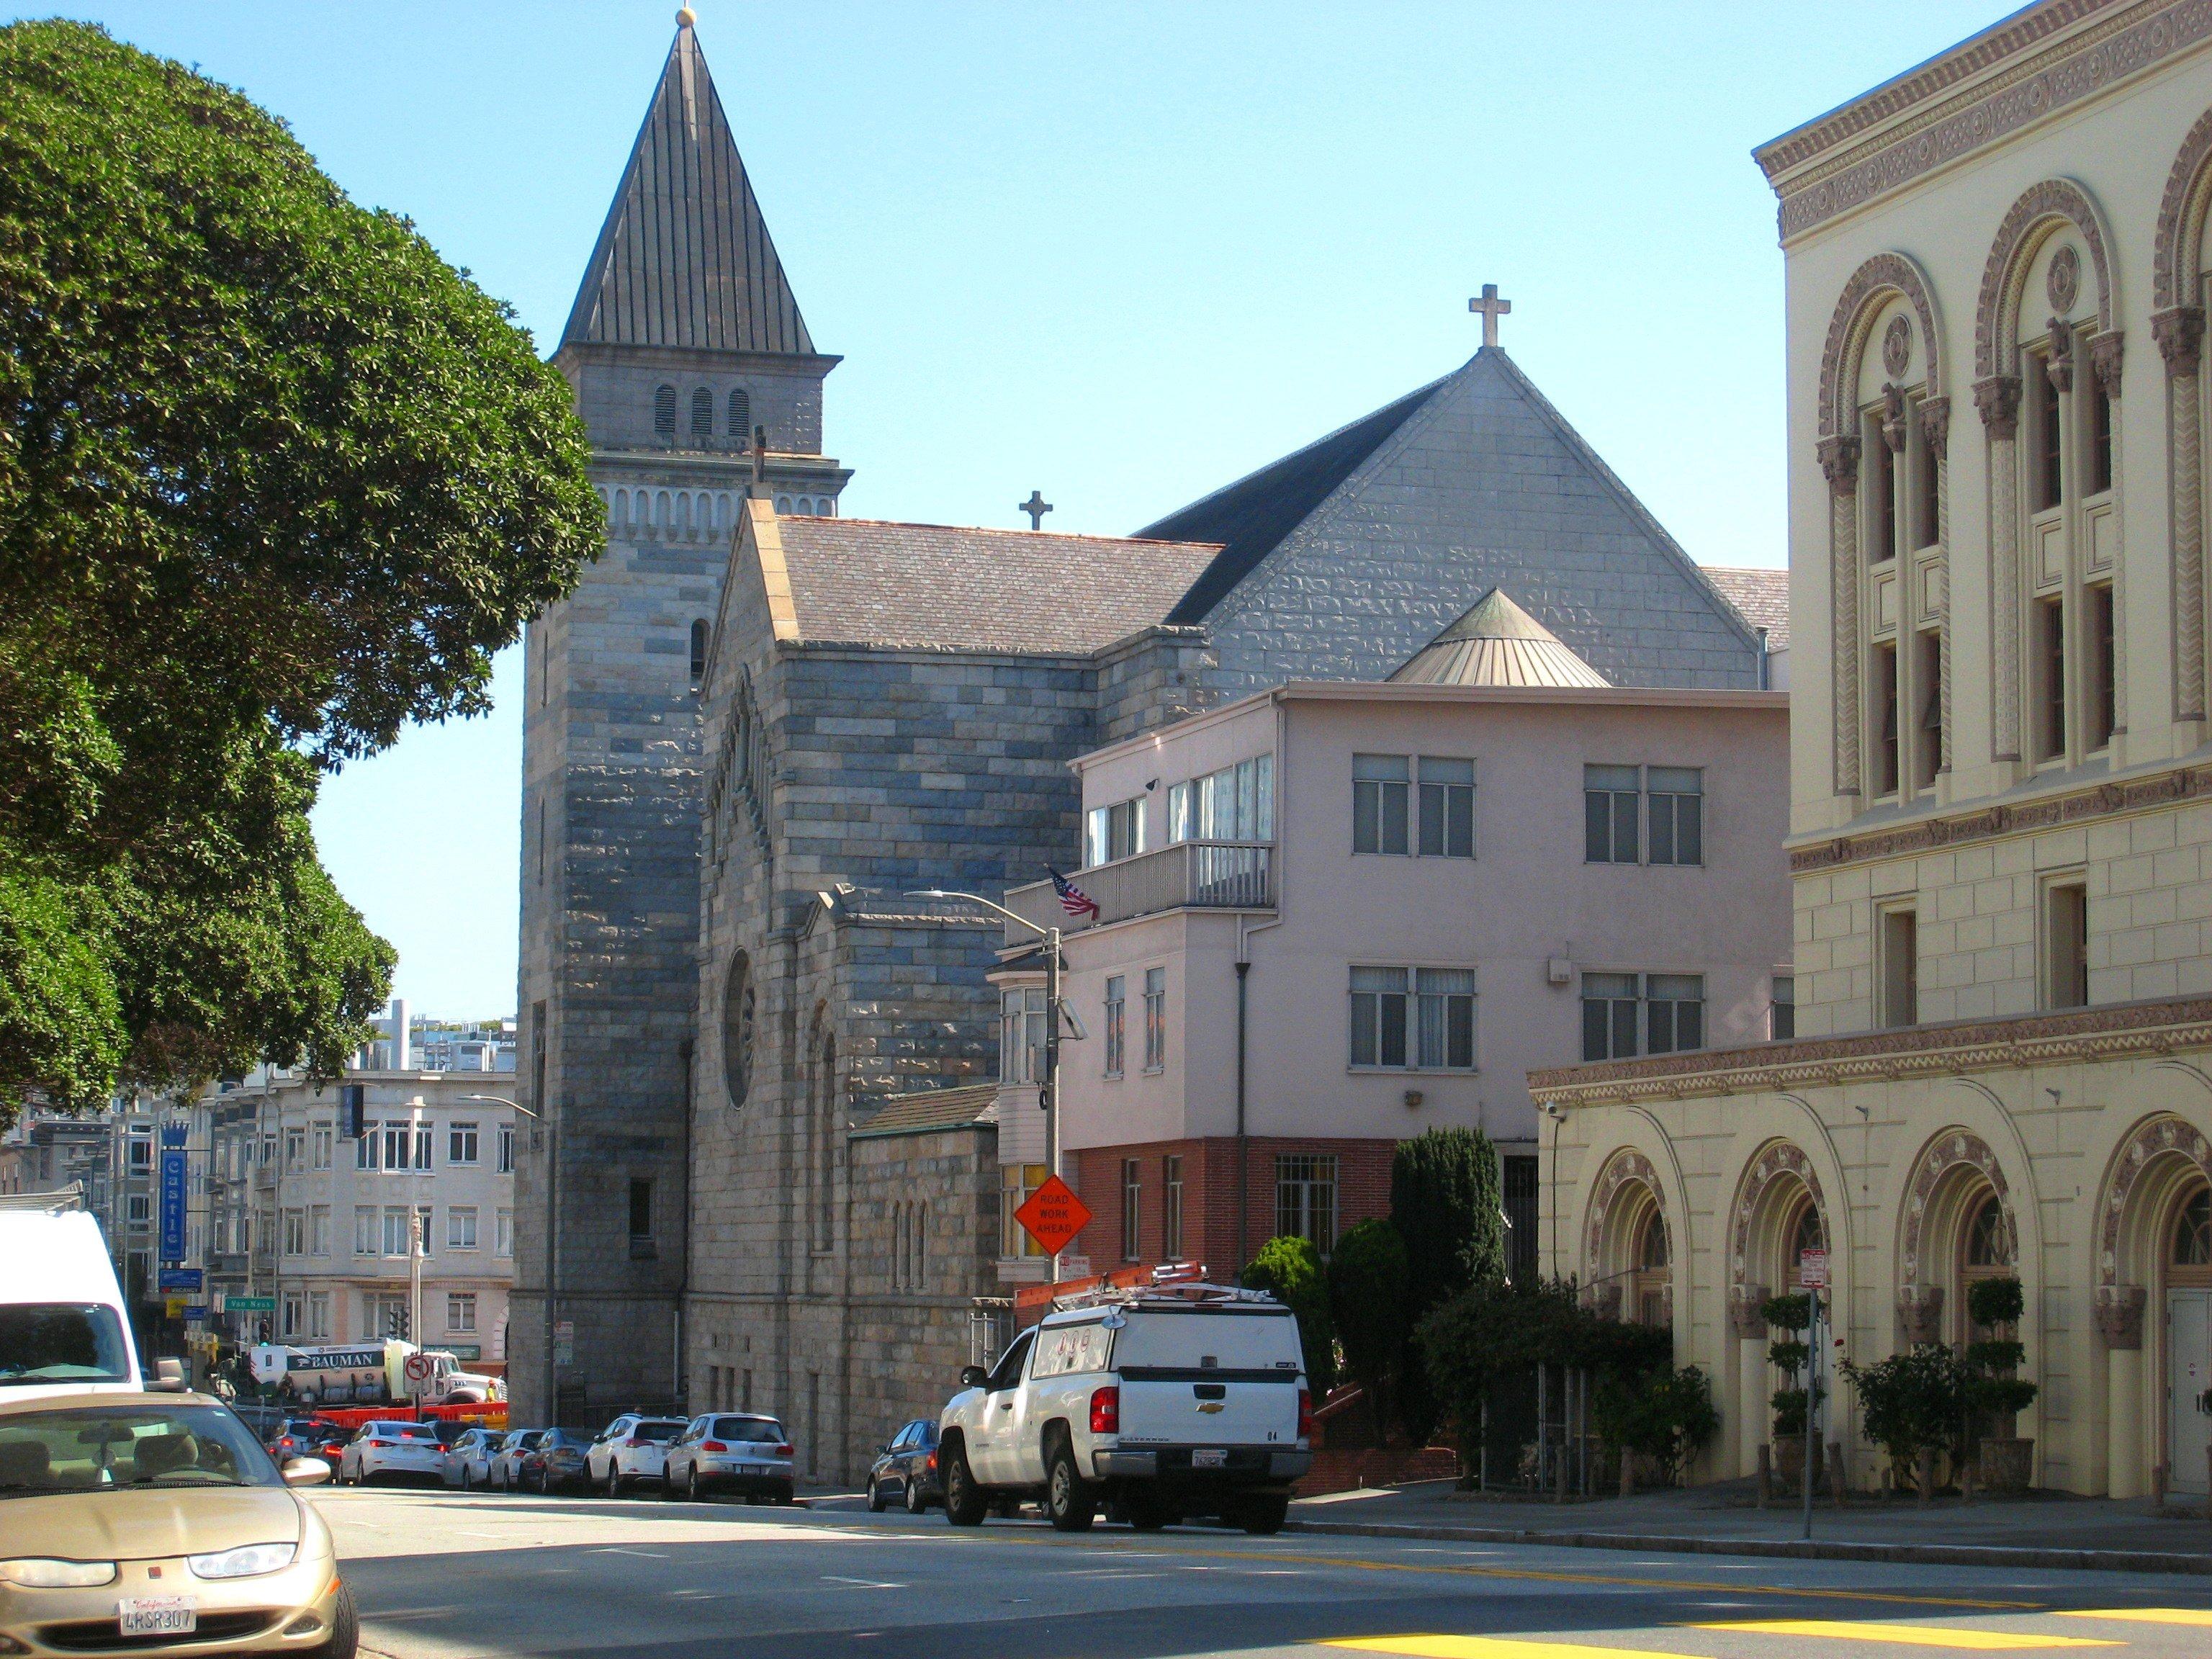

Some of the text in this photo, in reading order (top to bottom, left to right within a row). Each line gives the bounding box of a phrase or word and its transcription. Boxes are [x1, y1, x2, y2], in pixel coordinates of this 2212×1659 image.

[167, 1160, 179, 1244] Castle
[1040, 1195, 1069, 1205] ROAD
[1040, 1210, 1069, 1219] WORK
[1036, 1225, 1072, 1233] AHEAD
[310, 1354, 373, 1368] BAUMAN
